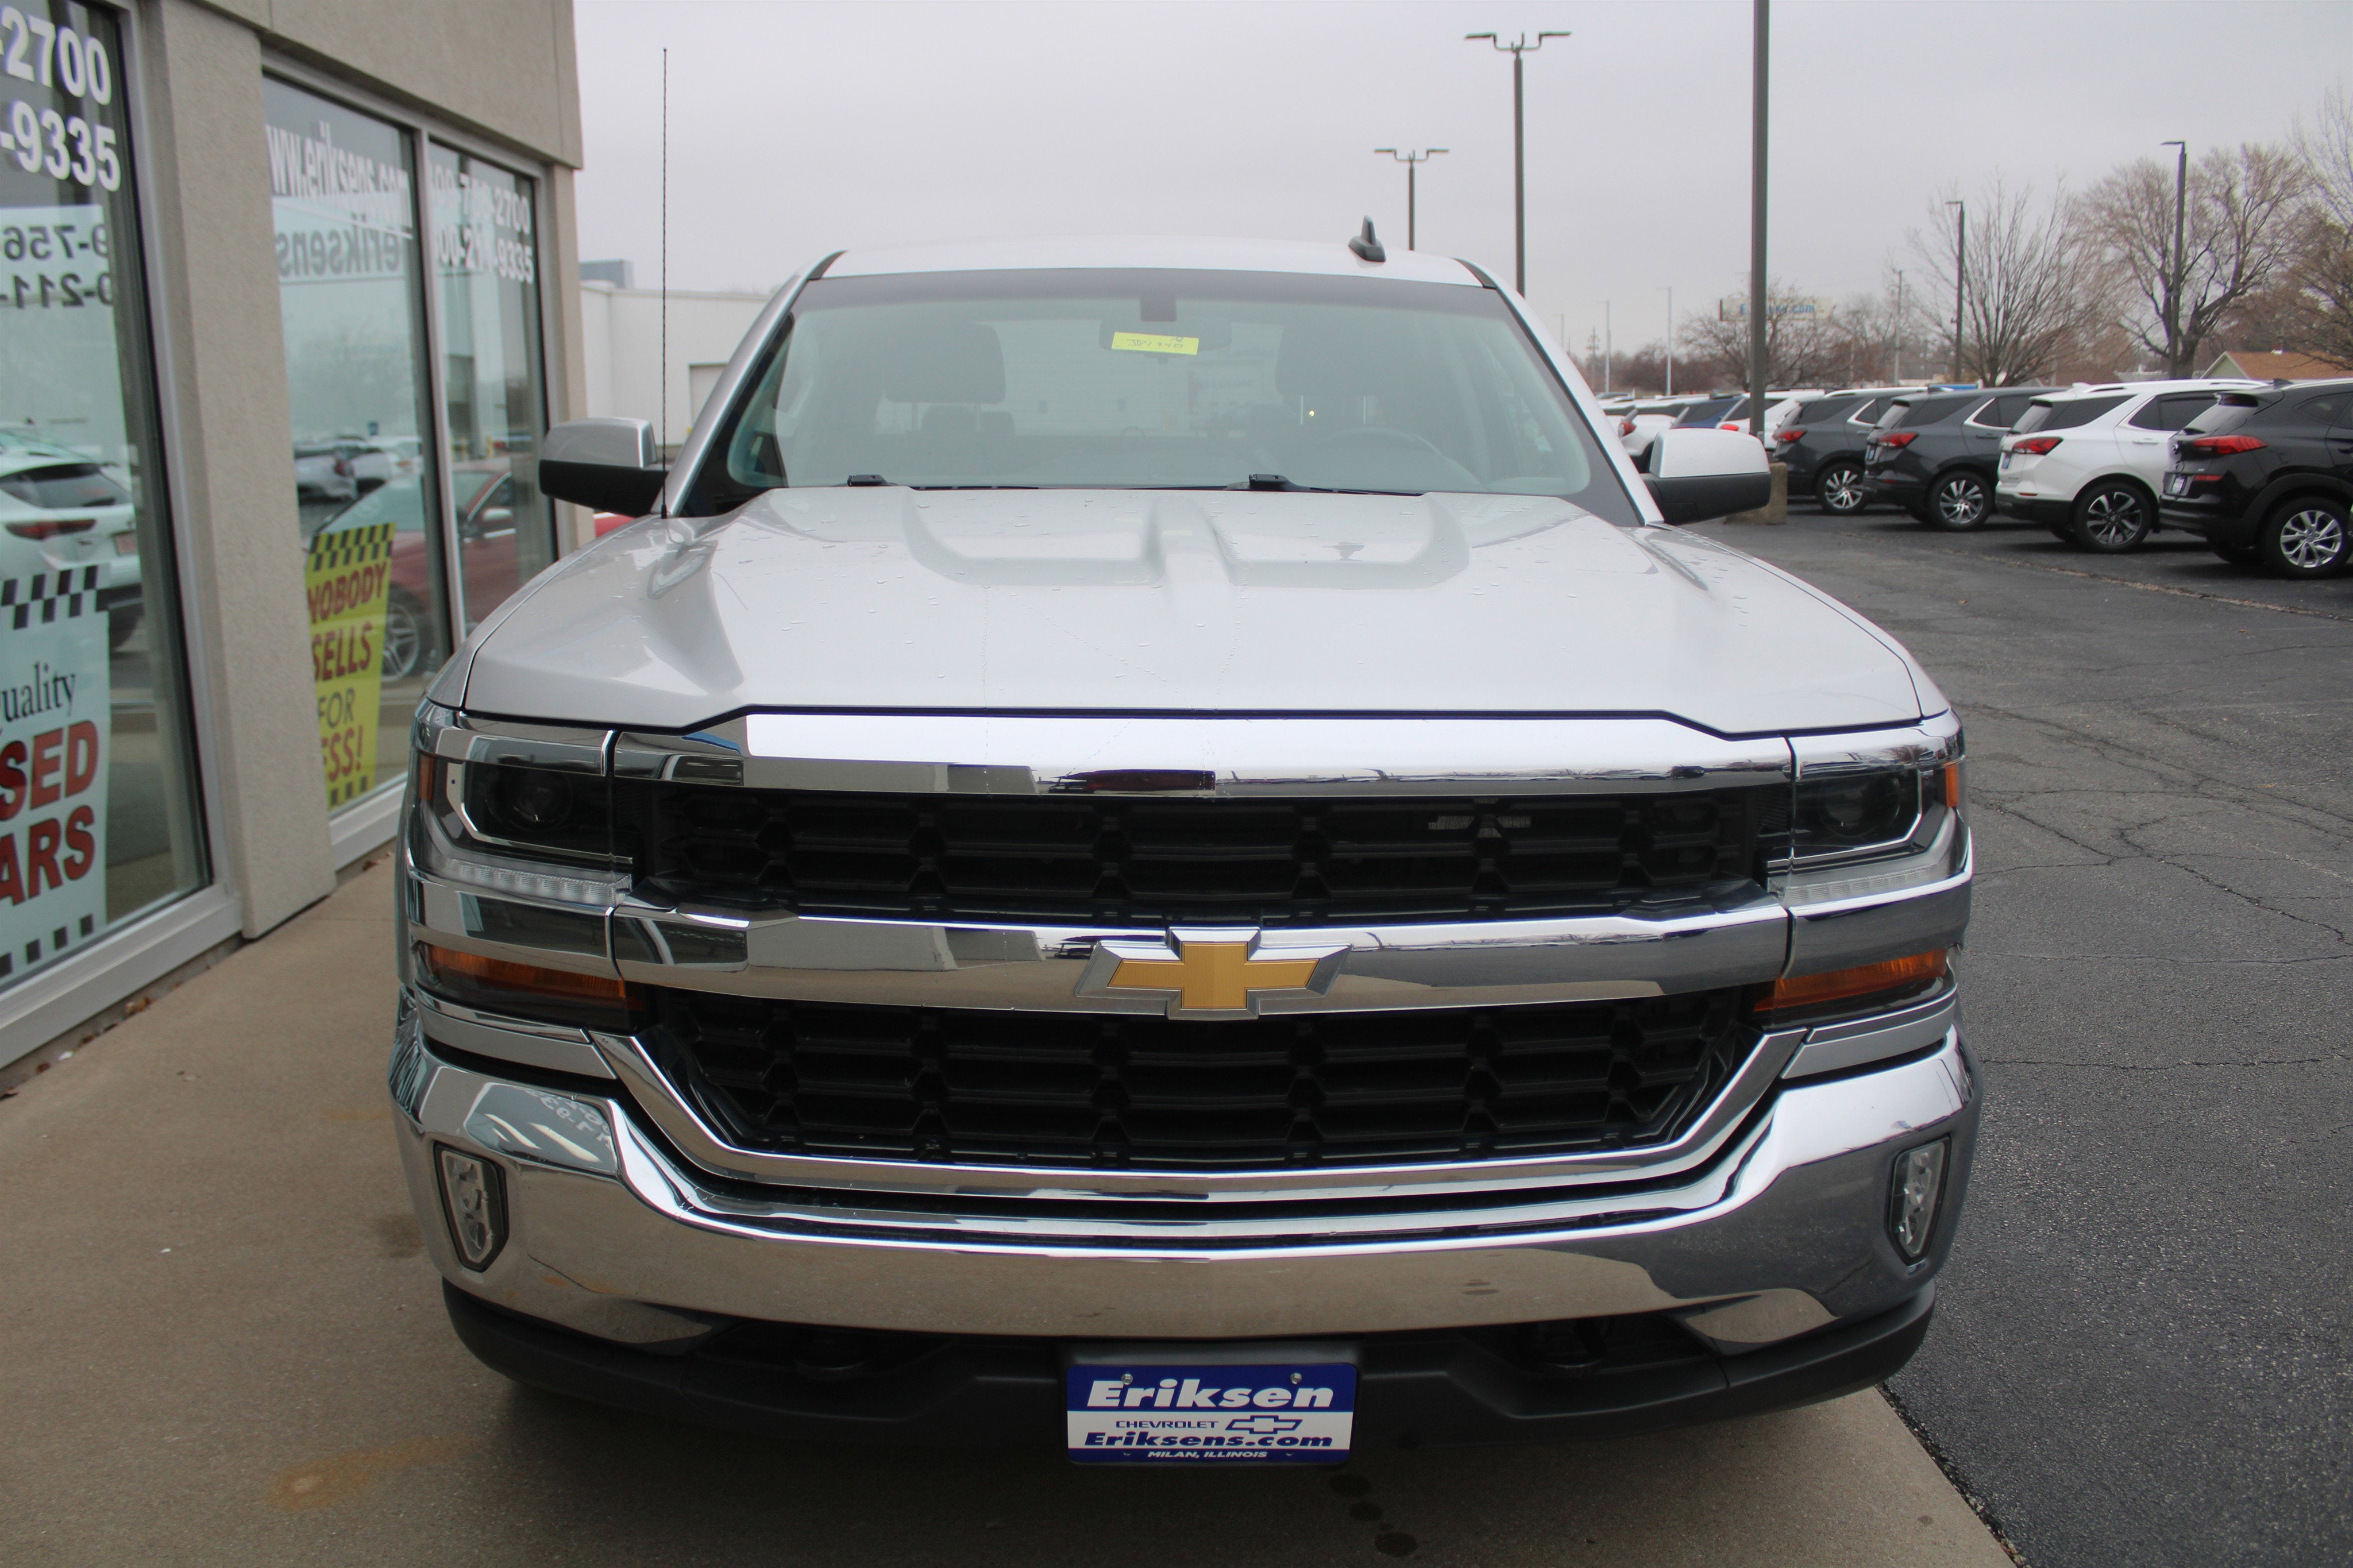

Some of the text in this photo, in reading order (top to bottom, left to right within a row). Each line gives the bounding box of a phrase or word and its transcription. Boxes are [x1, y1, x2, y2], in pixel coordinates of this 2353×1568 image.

[0, 6, 112, 106] 2700
[308, 561, 387, 623] NOBODY
[312, 622, 372, 681] SELLS
[0, 662, 76, 723] uality
[318, 687, 354, 728] FOR
[1087, 1378, 1334, 1407] Eriksen
[1085, 1431, 1333, 1447] Eriksens.com
[1116, 1420, 1219, 1429] CHEVROLET
